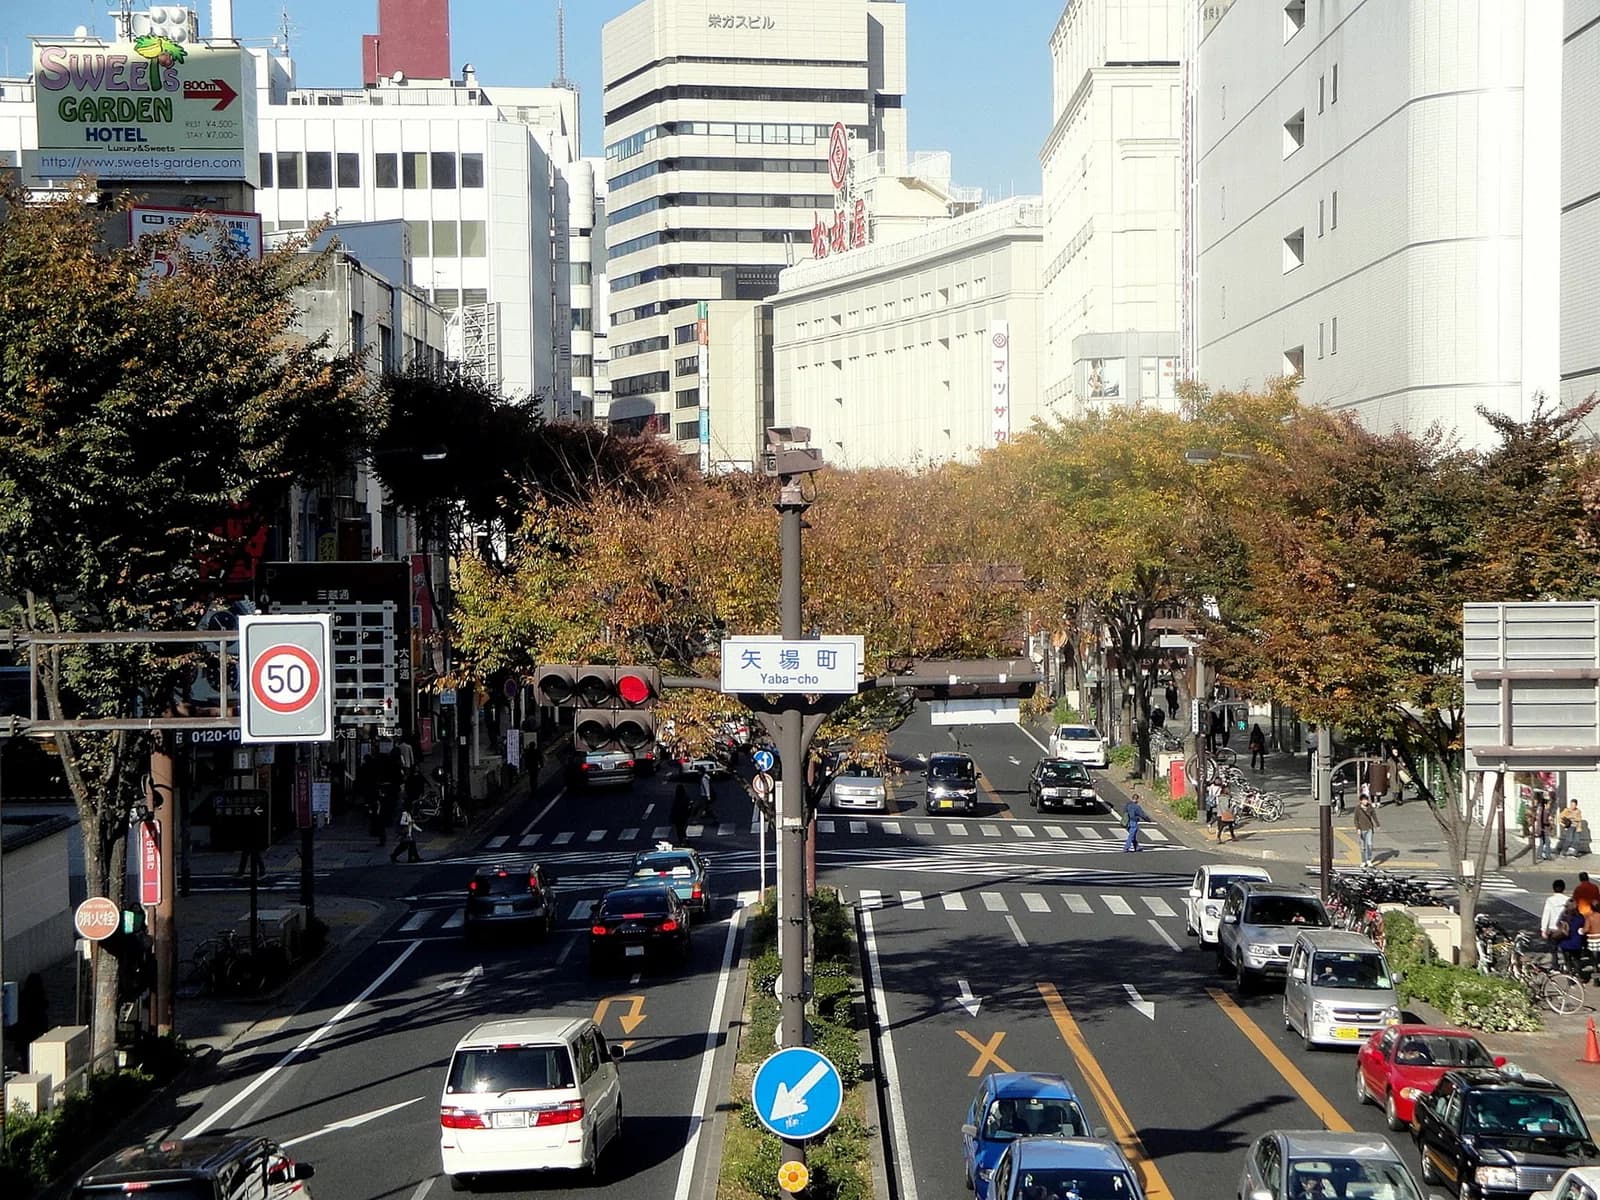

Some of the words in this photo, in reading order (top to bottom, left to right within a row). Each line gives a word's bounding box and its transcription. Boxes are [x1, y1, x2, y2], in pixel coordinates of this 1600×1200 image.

[708, 13, 775, 30] 栄ガスビル
[183, 80, 216, 91] 800m
[58, 96, 173, 123] GARDEN
[85, 127, 148, 142] HOTEL
[41, 156, 242, 169] http://www.sweets-garden.com
[740, 649, 838, 671] 矢場町
[267, 664, 305, 694] 50
[760, 673, 819, 685] Yaba-cho
[79, 911, 115, 927] 消火栓
